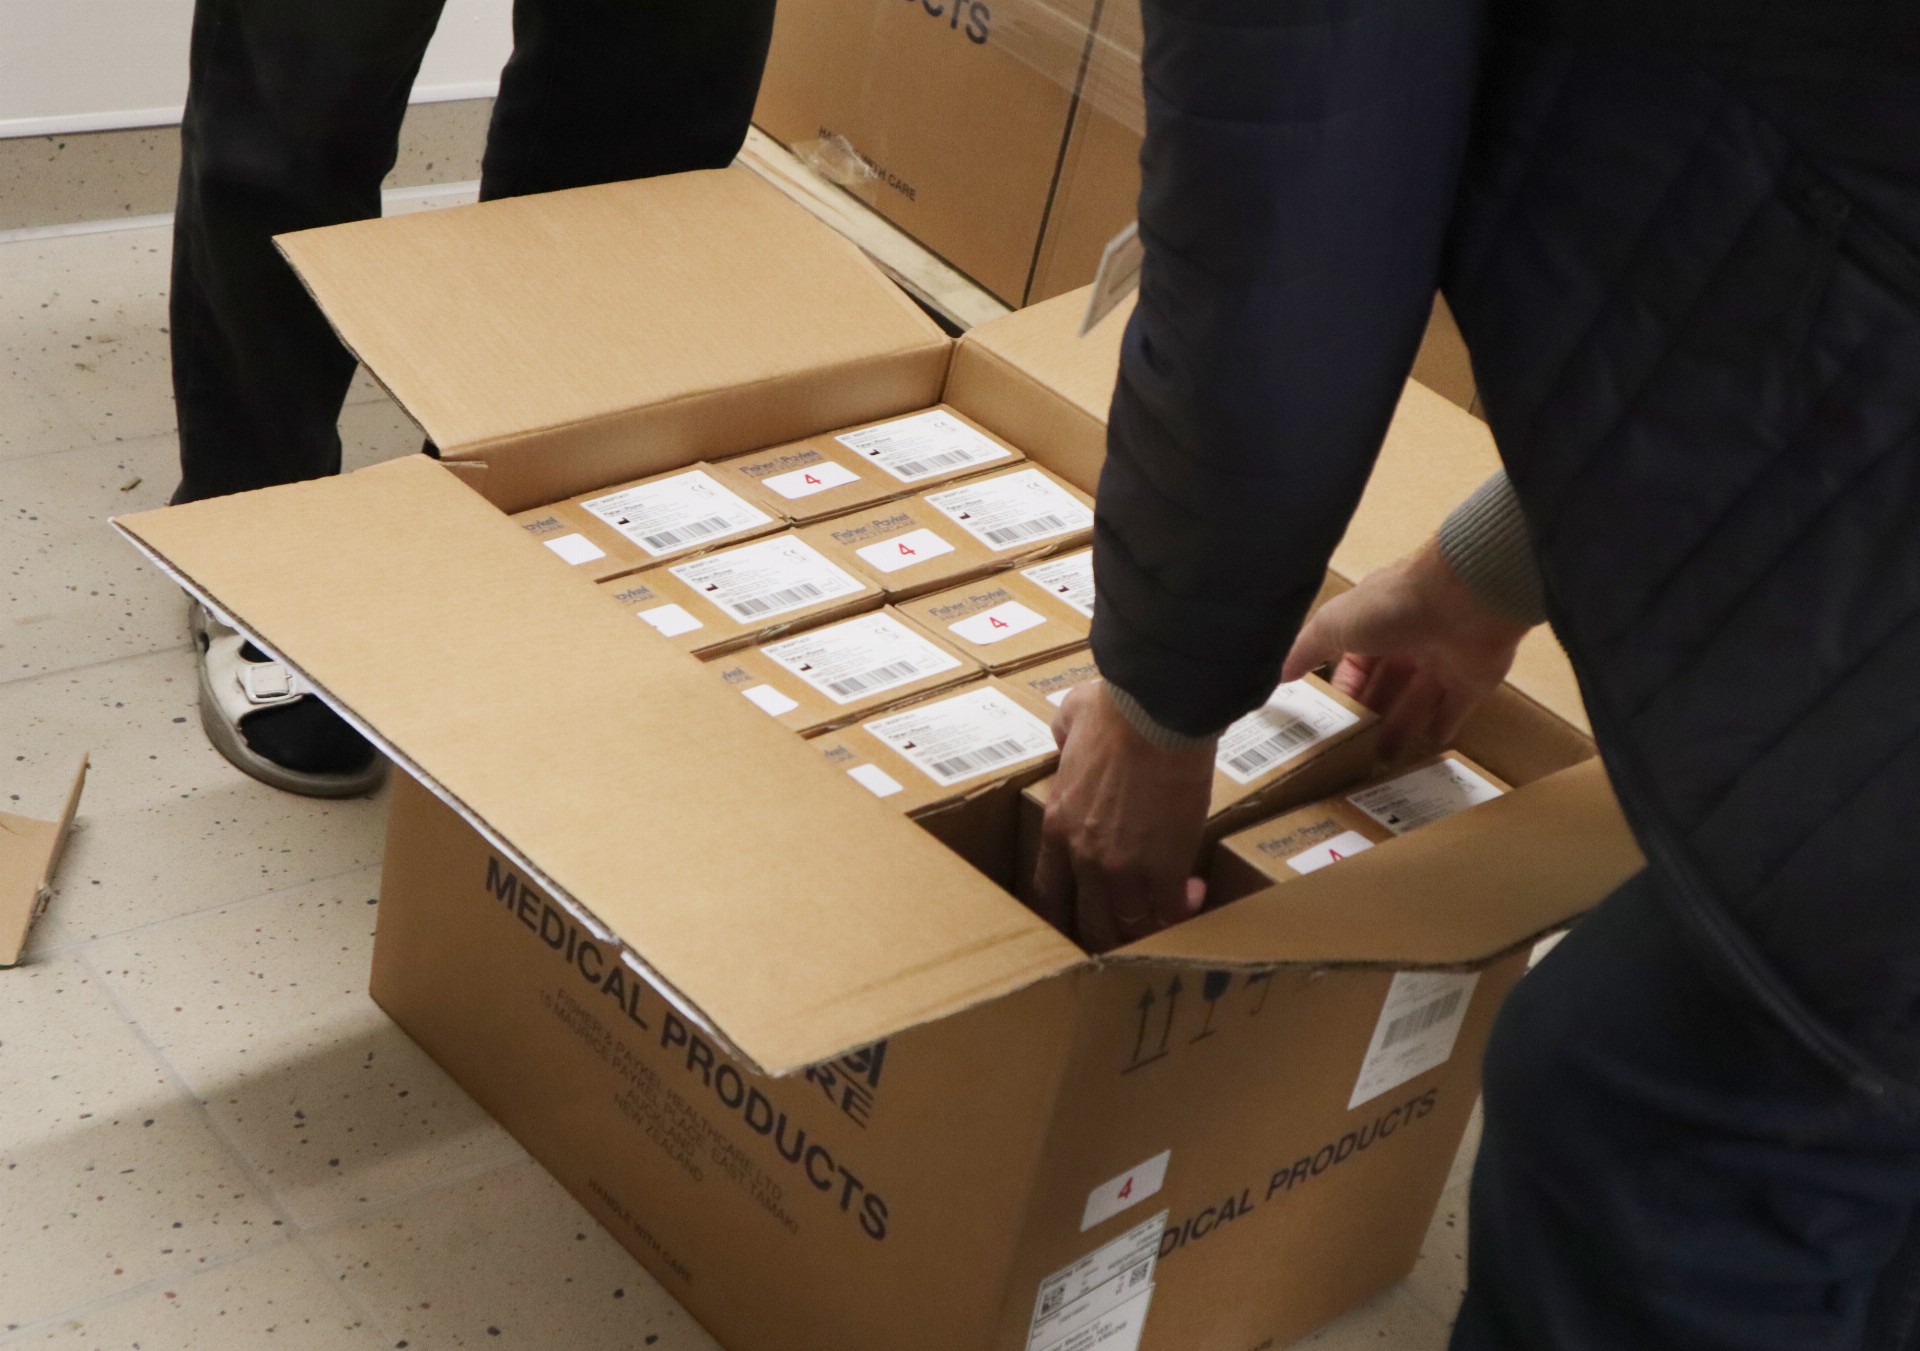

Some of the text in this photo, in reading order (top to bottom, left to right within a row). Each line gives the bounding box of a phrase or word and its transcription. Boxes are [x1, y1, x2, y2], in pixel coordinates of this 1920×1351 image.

[888, 173, 917, 202] CARE
[804, 473, 822, 485] 4
[898, 543, 916, 556] 4
[989, 616, 1009, 629] 4
[485, 855, 649, 1031] MEDICAL
[659, 1012, 890, 1241] PRODUCTS
[616, 1041, 663, 1090] PAYKEL
[667, 1087, 756, 1170] HEALTHCARE
[756, 1168, 783, 1201] LTD
[1157, 1188, 1255, 1258] DICAL
[1265, 1087, 1440, 1202] PRODUCTS
[1117, 1176, 1134, 1200] 4
